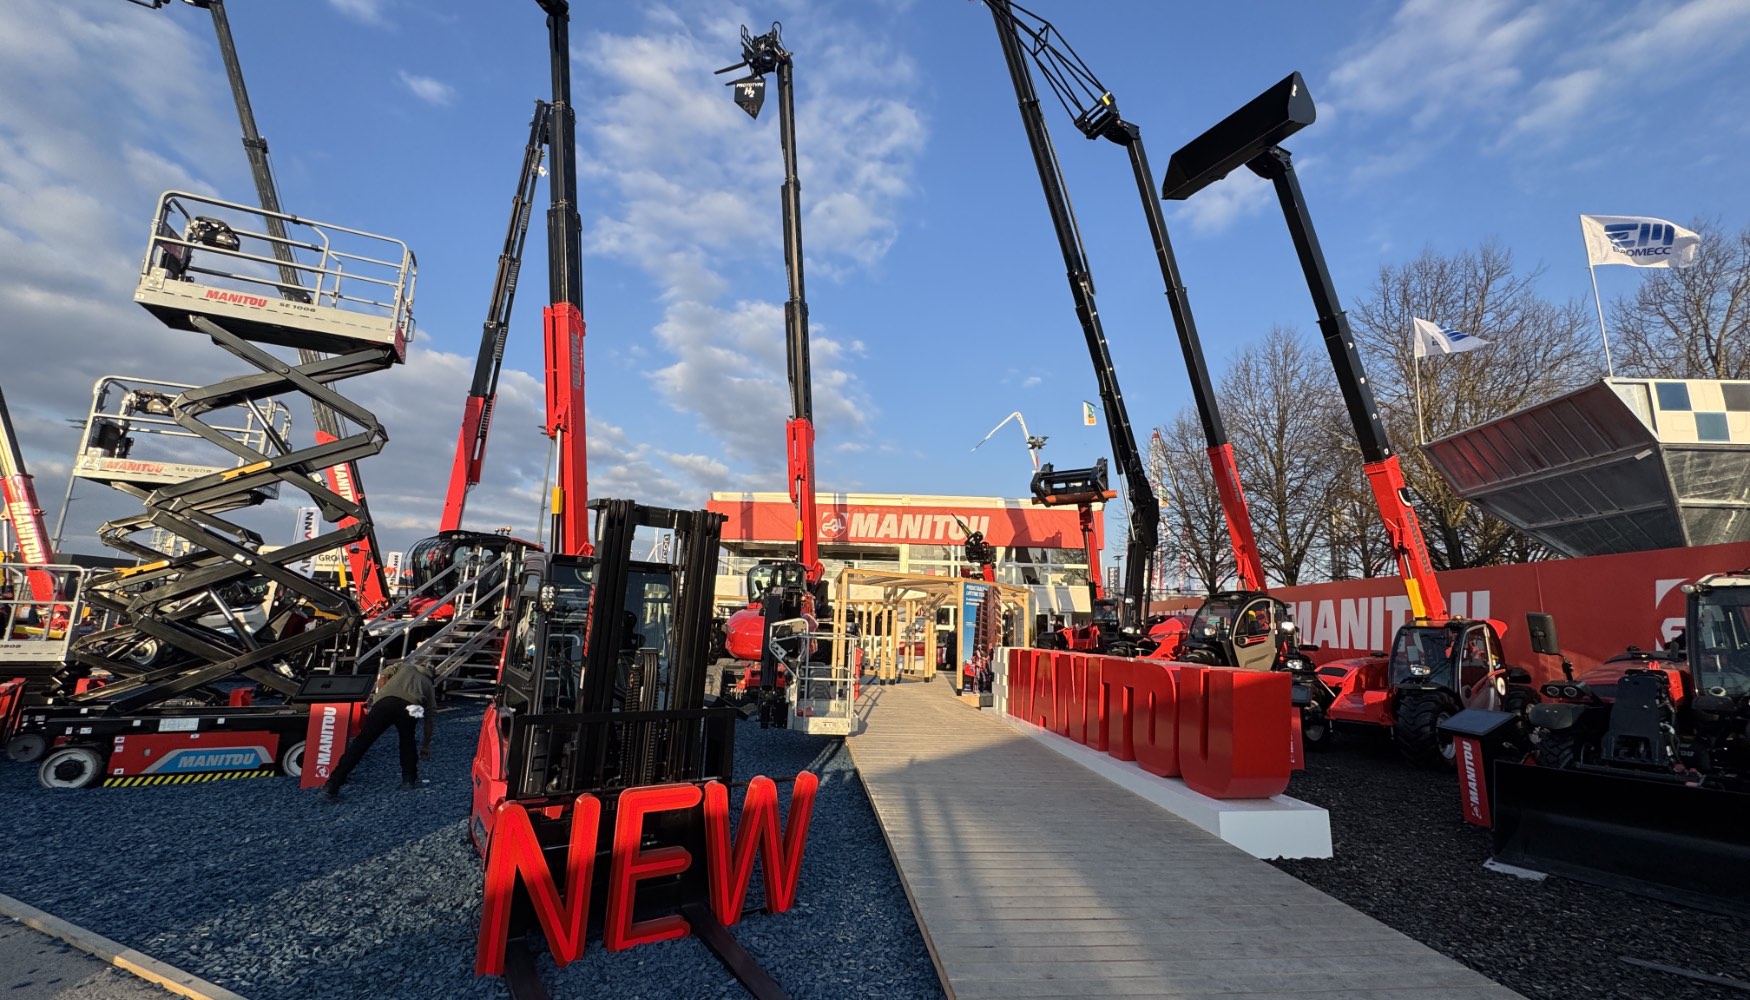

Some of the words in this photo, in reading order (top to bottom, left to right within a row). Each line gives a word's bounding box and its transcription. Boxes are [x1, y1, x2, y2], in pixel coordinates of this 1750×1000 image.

[744, 86, 756, 98] H2
[205, 289, 268, 308] MANITOU
[105, 461, 165, 474] MANITOU
[333, 462, 354, 503] MANIT
[10, 501, 44, 564] MANITOU
[850, 512, 990, 541] MANITOU
[1405, 510, 1431, 576] MANITOU
[317, 706, 337, 766] MANITOU
[1008, 648, 1291, 799] MANITOU
[177, 753, 256, 768] MANITOU
[1462, 741, 1480, 806] MANITOU
[475, 770, 819, 976] NEW
